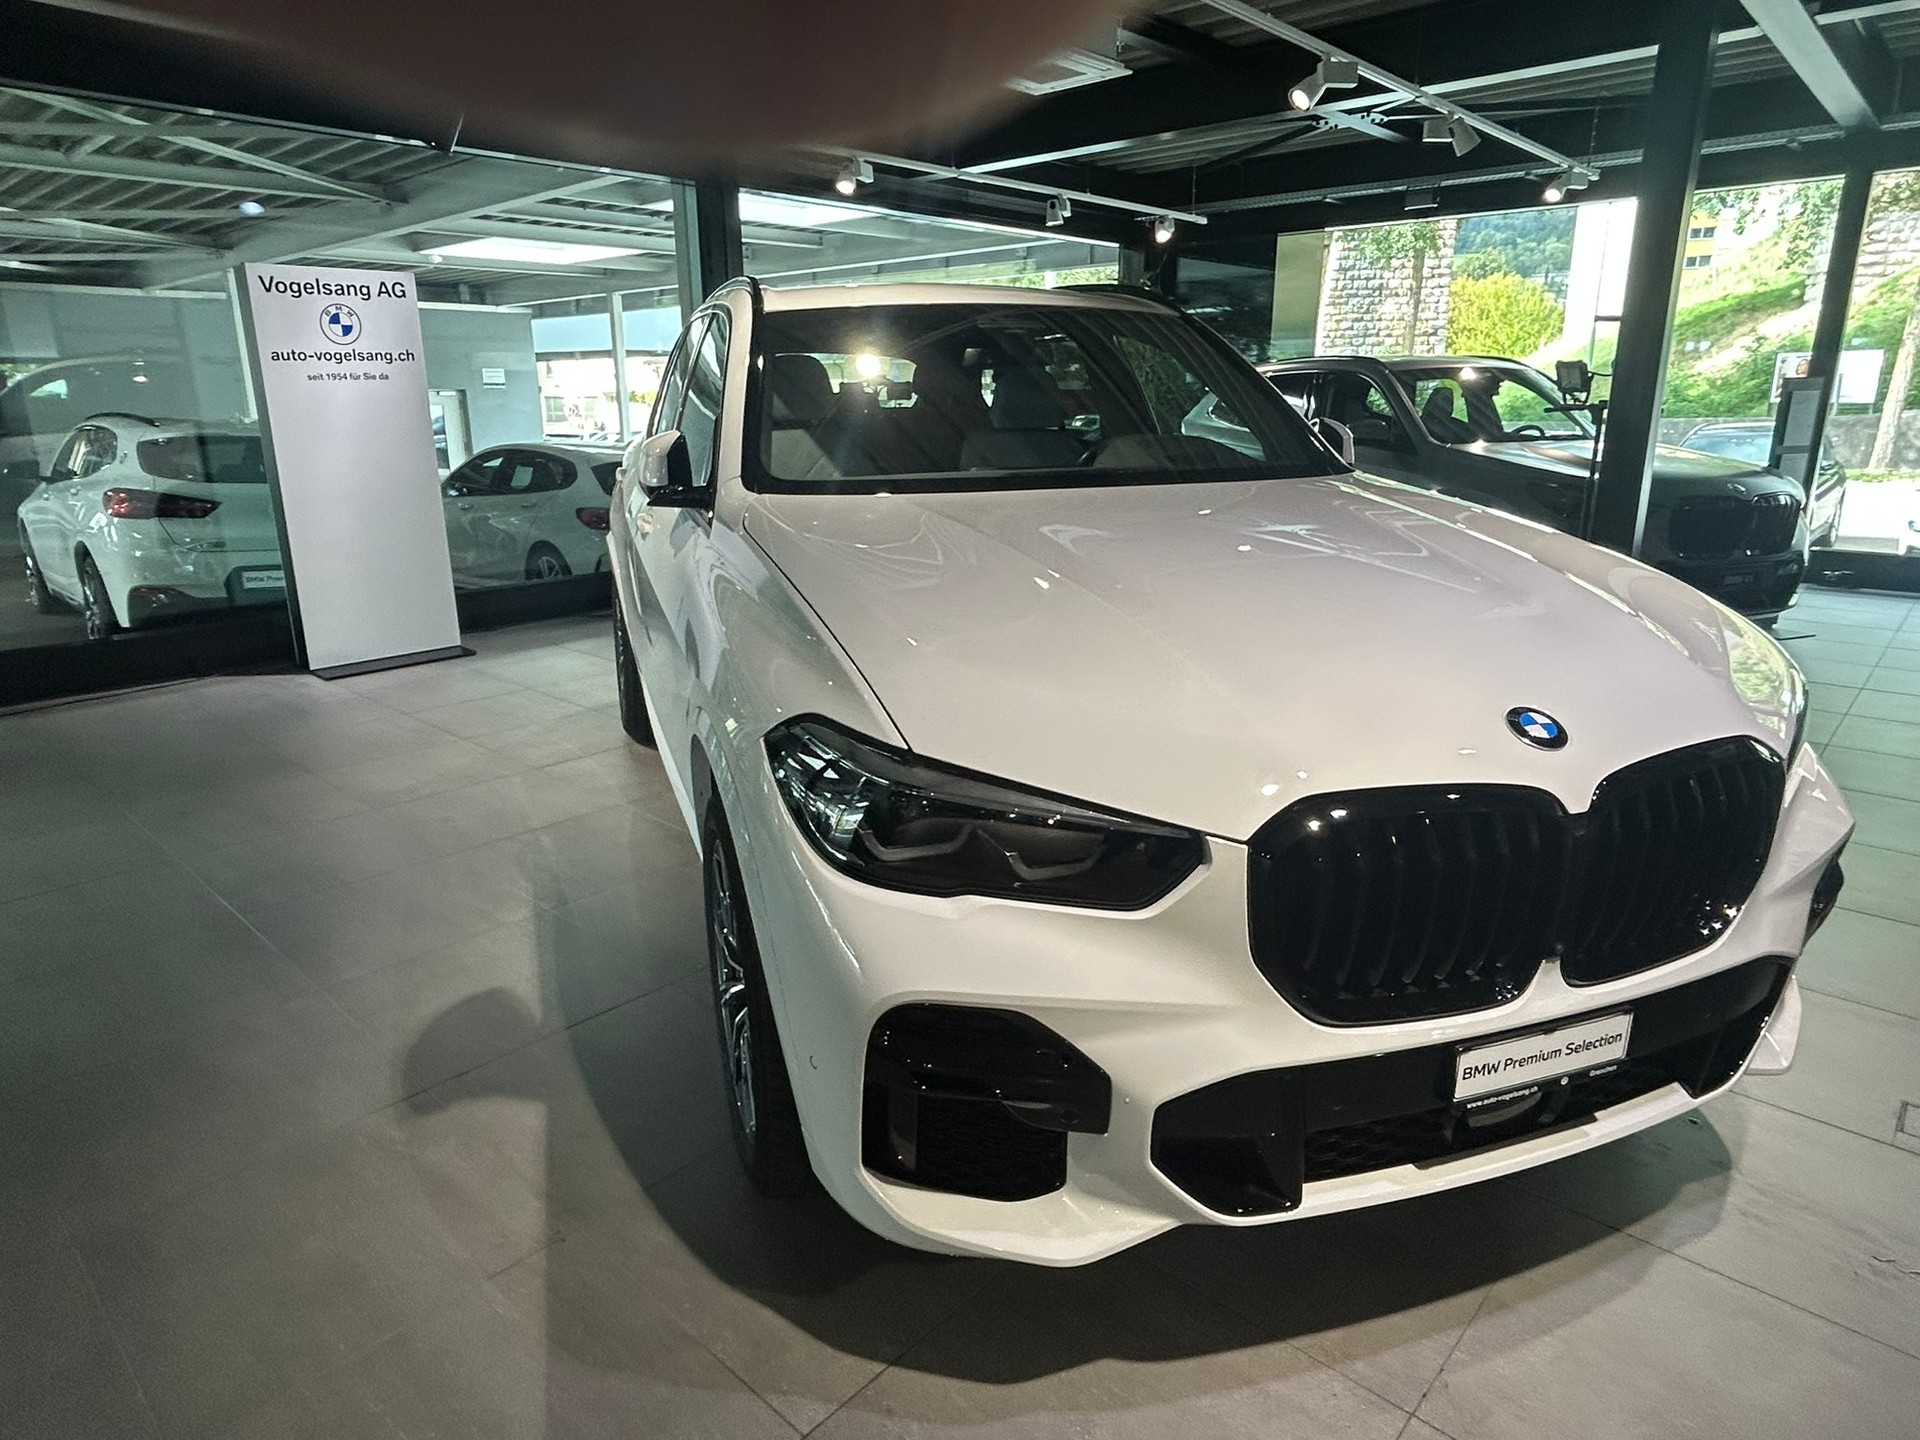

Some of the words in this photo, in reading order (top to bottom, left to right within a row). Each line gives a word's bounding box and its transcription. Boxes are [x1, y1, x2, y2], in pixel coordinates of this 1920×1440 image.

[258, 275, 371, 301] Vogelsang
[377, 281, 407, 299] AG
[271, 349, 415, 364] auto-vogelsang.ch
[307, 373, 324, 381] seit
[326, 373, 348, 381] 1954
[349, 373, 362, 381] für
[363, 373, 377, 381] Sie
[378, 373, 389, 381] da
[1462, 1060, 1501, 1081] BMW
[1503, 1049, 1562, 1071] Premium
[1565, 1033, 1622, 1056] Selection
